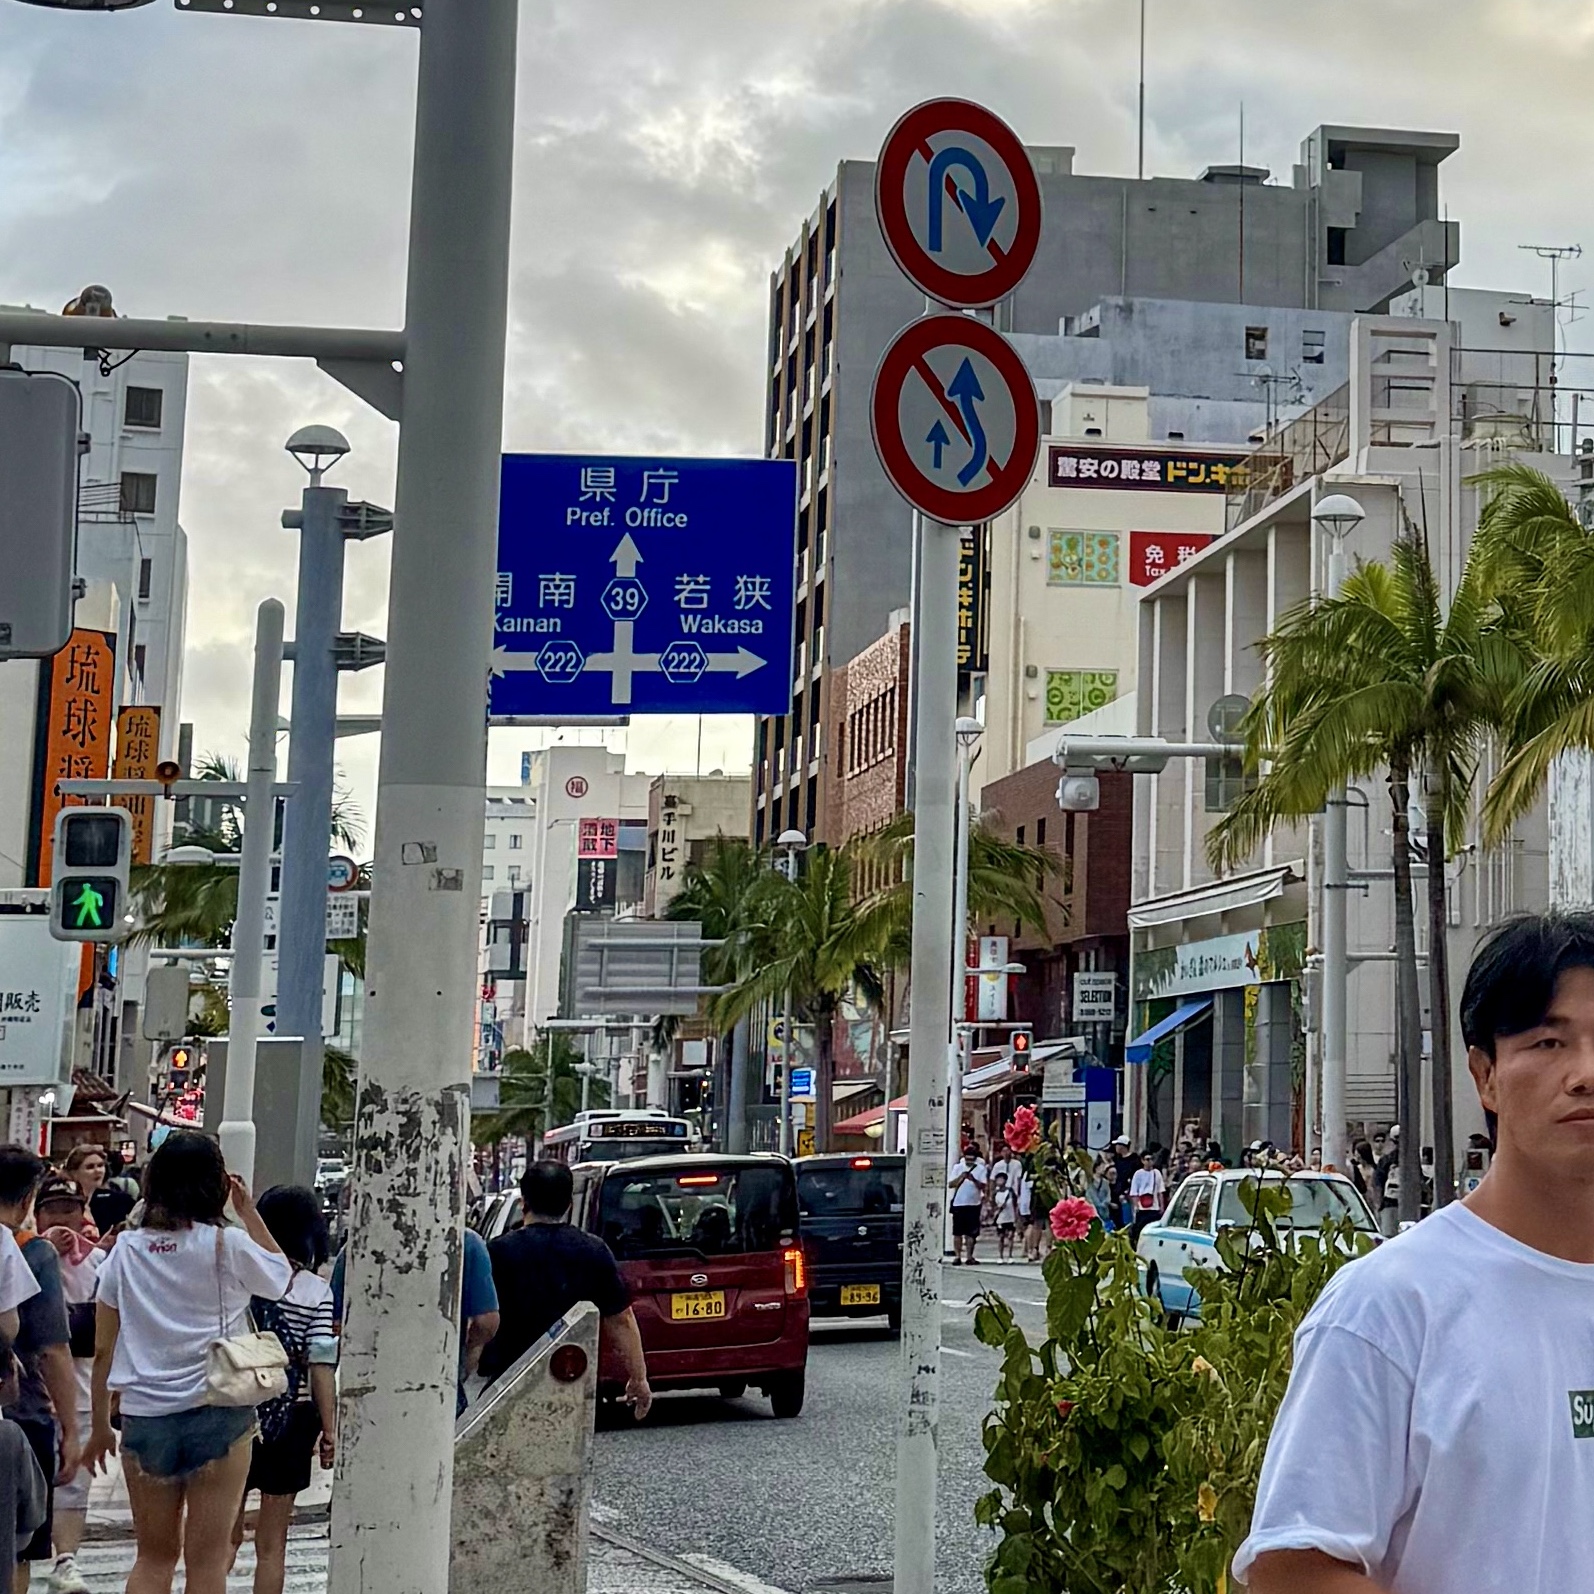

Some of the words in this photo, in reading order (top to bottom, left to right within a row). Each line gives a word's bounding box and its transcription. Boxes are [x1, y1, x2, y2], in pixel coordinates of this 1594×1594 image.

[1057, 456, 1161, 482] 驚安の殿堂
[579, 467, 679, 503] 県庁
[566, 507, 615, 526] Pref.
[625, 507, 688, 527] Office
[610, 587, 639, 611] 39
[673, 573, 772, 610] 若狭
[680, 614, 763, 634] Wakasa
[544, 652, 576, 672] 222
[668, 652, 700, 672] 222
[53, 644, 101, 800] 琉球将
[0, 990, 41, 1012] 販売
